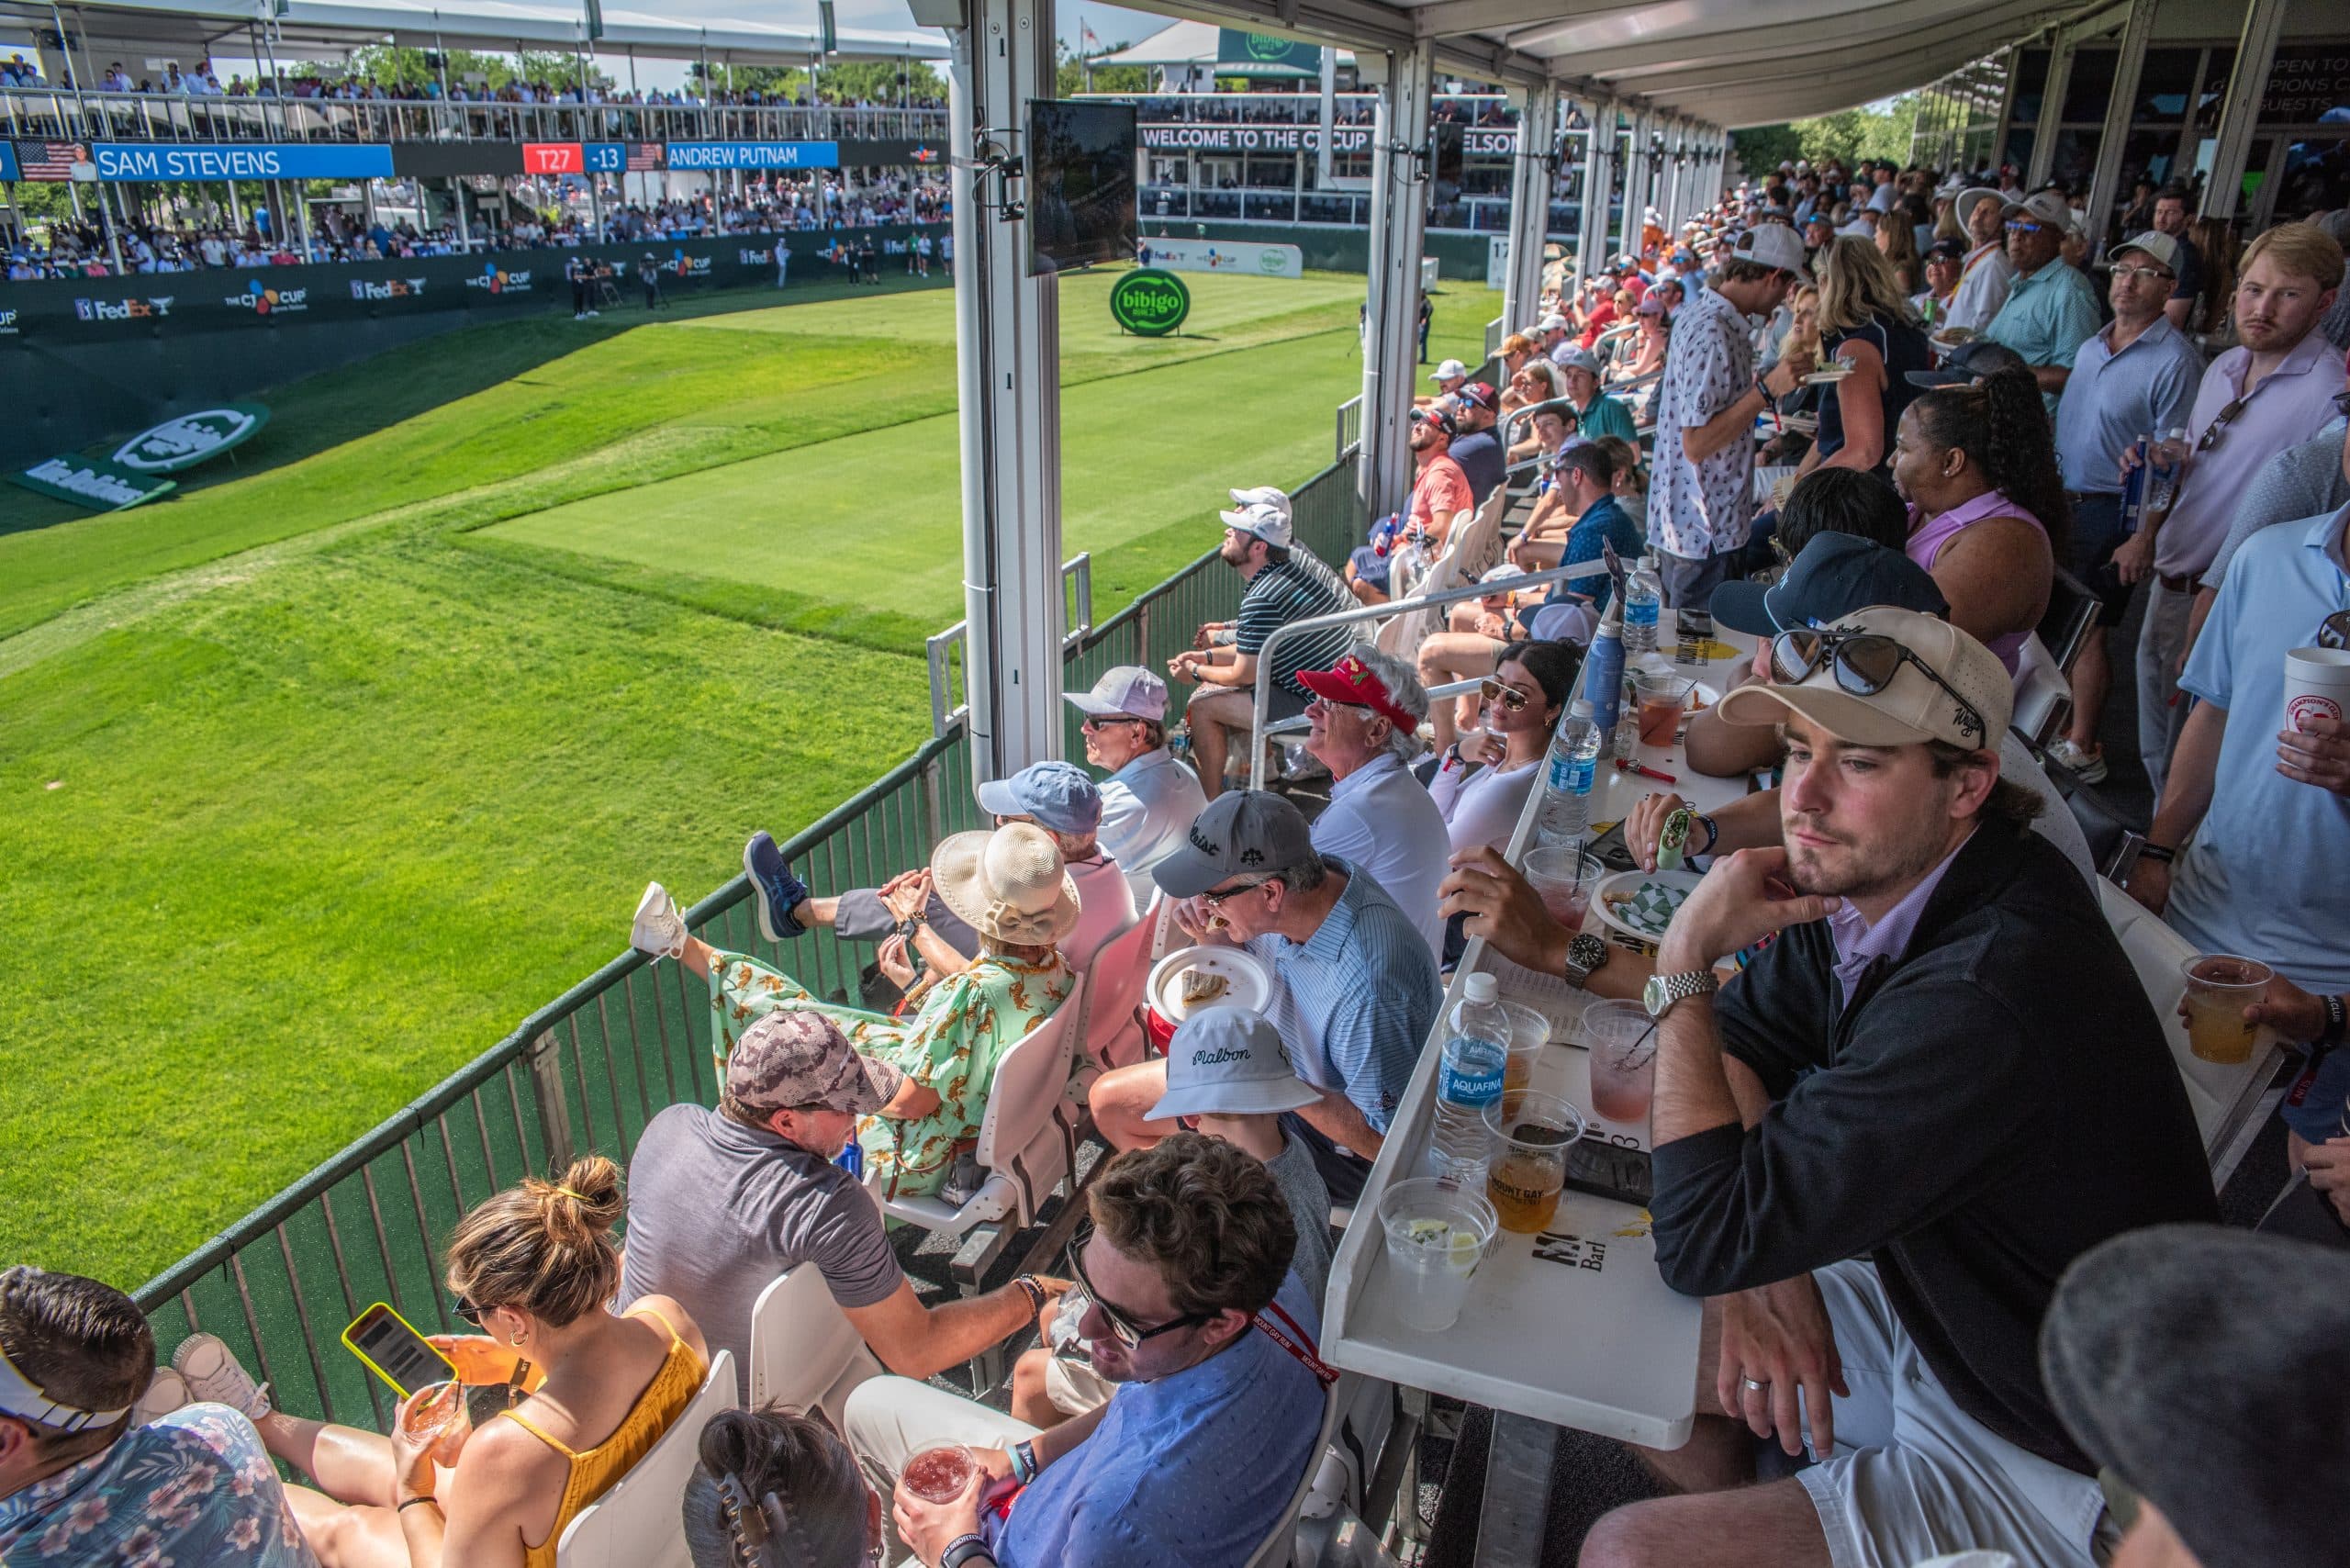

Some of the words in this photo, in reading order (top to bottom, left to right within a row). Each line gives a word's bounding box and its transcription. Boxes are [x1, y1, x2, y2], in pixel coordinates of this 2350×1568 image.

[1143, 129, 1230, 148] WELCOME
[1234, 130, 1259, 148] TO
[1262, 130, 1299, 148] THE
[1334, 131, 1368, 150] CUP
[99, 151, 159, 176] SAM
[167, 151, 280, 175] STEVENS
[536, 150, 570, 170] T27
[591, 149, 619, 168] -13
[668, 148, 734, 165] ANDREW
[740, 147, 797, 164] PUTNAM
[509, 272, 530, 285] CUP
[241, 294, 256, 308] CJ
[279, 290, 306, 305] CUP
[364, 280, 408, 300] FedEx
[95, 299, 151, 320] FedEx
[1124, 290, 1179, 314] bibigo
[1192, 1047, 1251, 1066] Malbon
[1452, 1077, 1502, 1094] AQUAFINA
[1253, 1315, 1270, 1332] MOUNT
[1269, 1328, 1281, 1339] GAY
[1280, 1335, 1292, 1349] RUM
[1302, 1354, 1318, 1371] MOUNT
